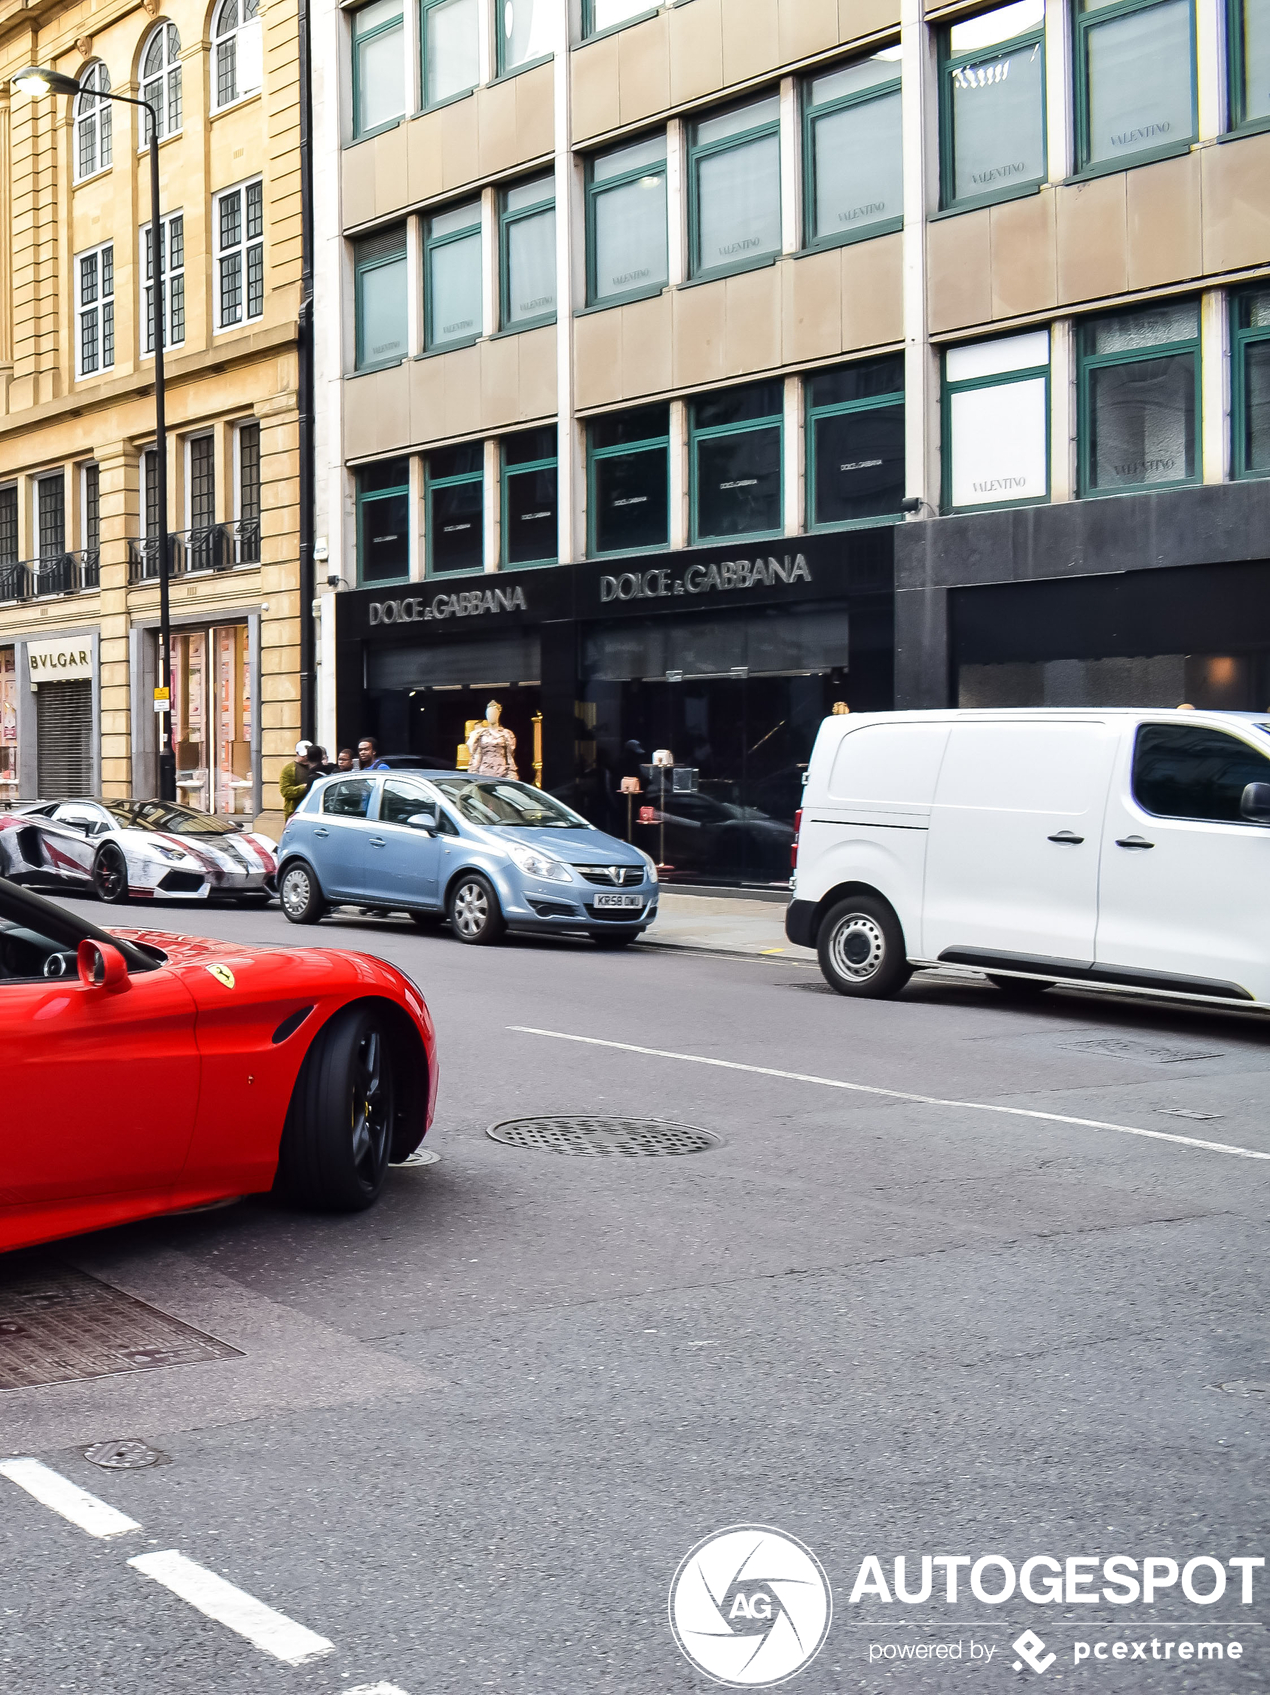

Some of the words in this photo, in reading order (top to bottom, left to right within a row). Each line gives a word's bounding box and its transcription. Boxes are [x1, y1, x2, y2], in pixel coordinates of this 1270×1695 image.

[1110, 121, 1171, 147] VALENTINO
[972, 162, 1025, 185] VALENTINO
[837, 201, 885, 222] VALENTINO
[718, 237, 760, 256] VALENTINO
[612, 268, 650, 286] VALENTINO
[519, 296, 553, 312] VALENTINO
[443, 319, 474, 334] VALENTINO
[1113, 458, 1176, 477] VALENTINO
[972, 476, 1026, 493] VALENTINO
[598, 896, 622, 906] KR58
